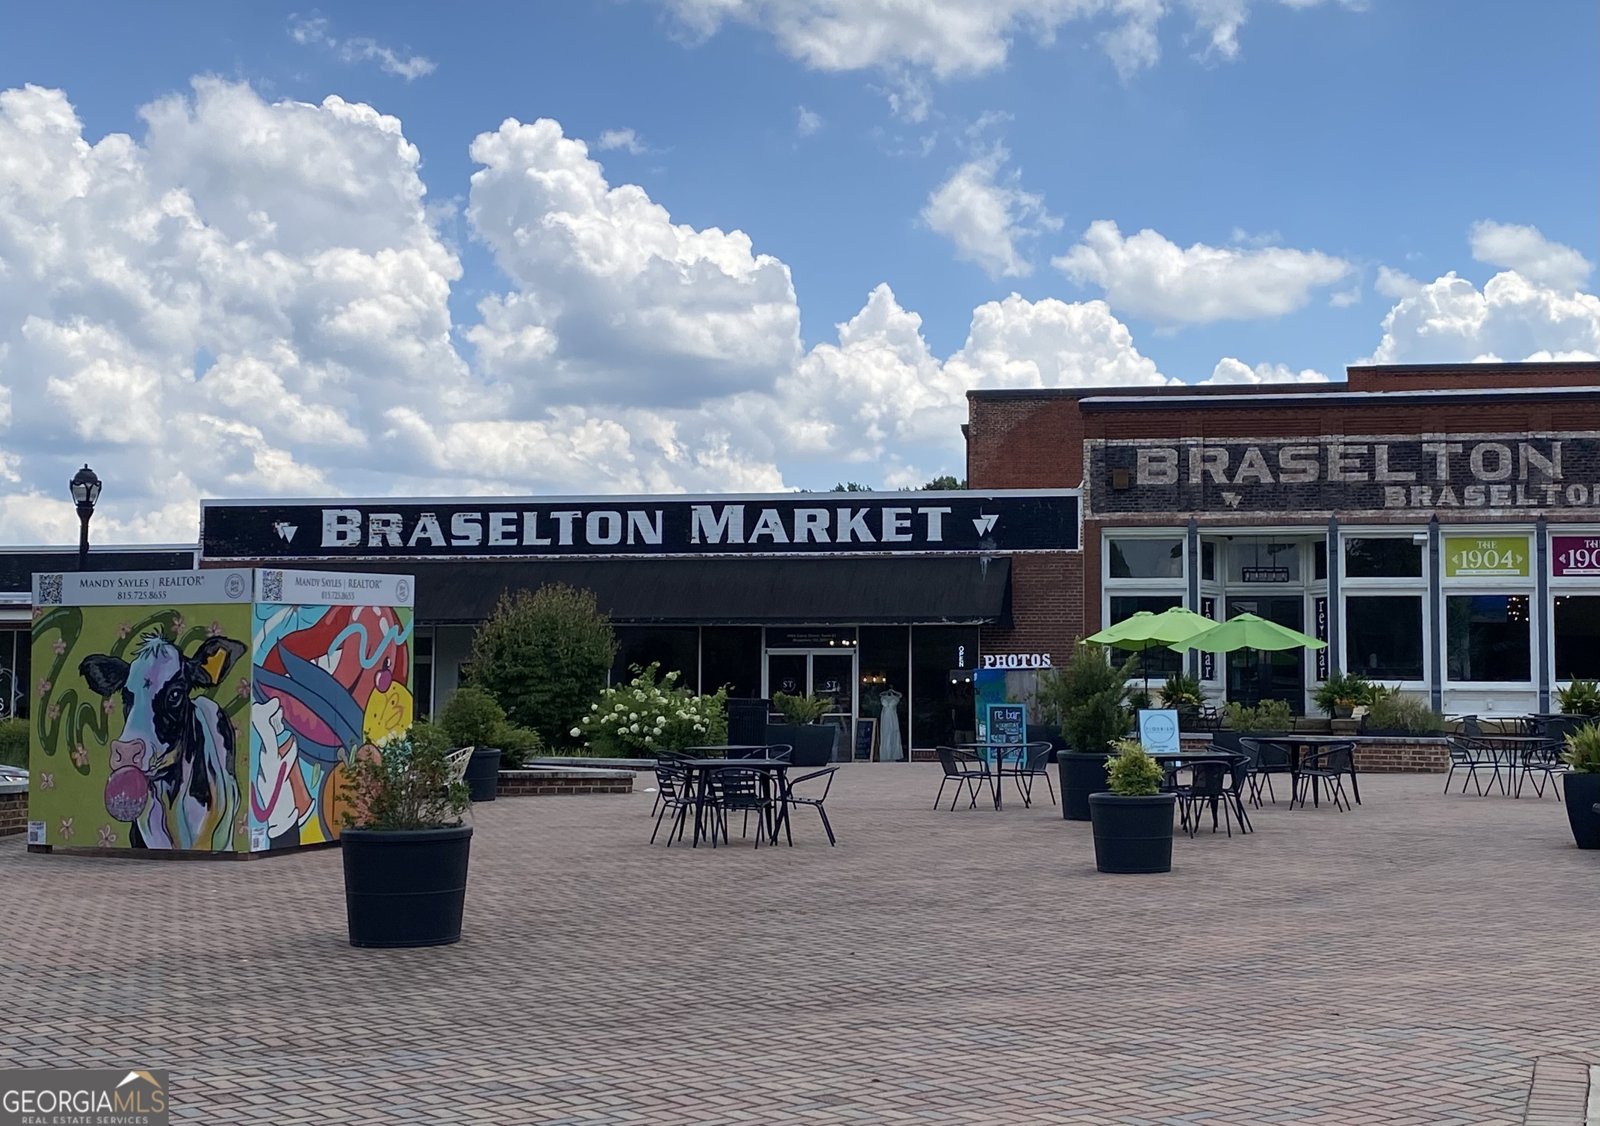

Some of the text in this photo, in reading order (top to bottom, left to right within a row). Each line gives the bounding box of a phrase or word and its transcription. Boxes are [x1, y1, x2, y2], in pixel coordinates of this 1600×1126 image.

[1135, 442, 1563, 485] BRASELTON
[321, 504, 951, 548] BRASELTON MARKET
[1477, 540, 1497, 549] THE
[1461, 549, 1514, 569] 1904
[79, 578, 116, 588] MANDY
[118, 577, 149, 588] SAYLES
[295, 577, 320, 587] MANDY
[321, 578, 342, 588] SAYLES
[117, 590, 167, 600] 815.725.8655
[984, 653, 1051, 670] PHOTOS
